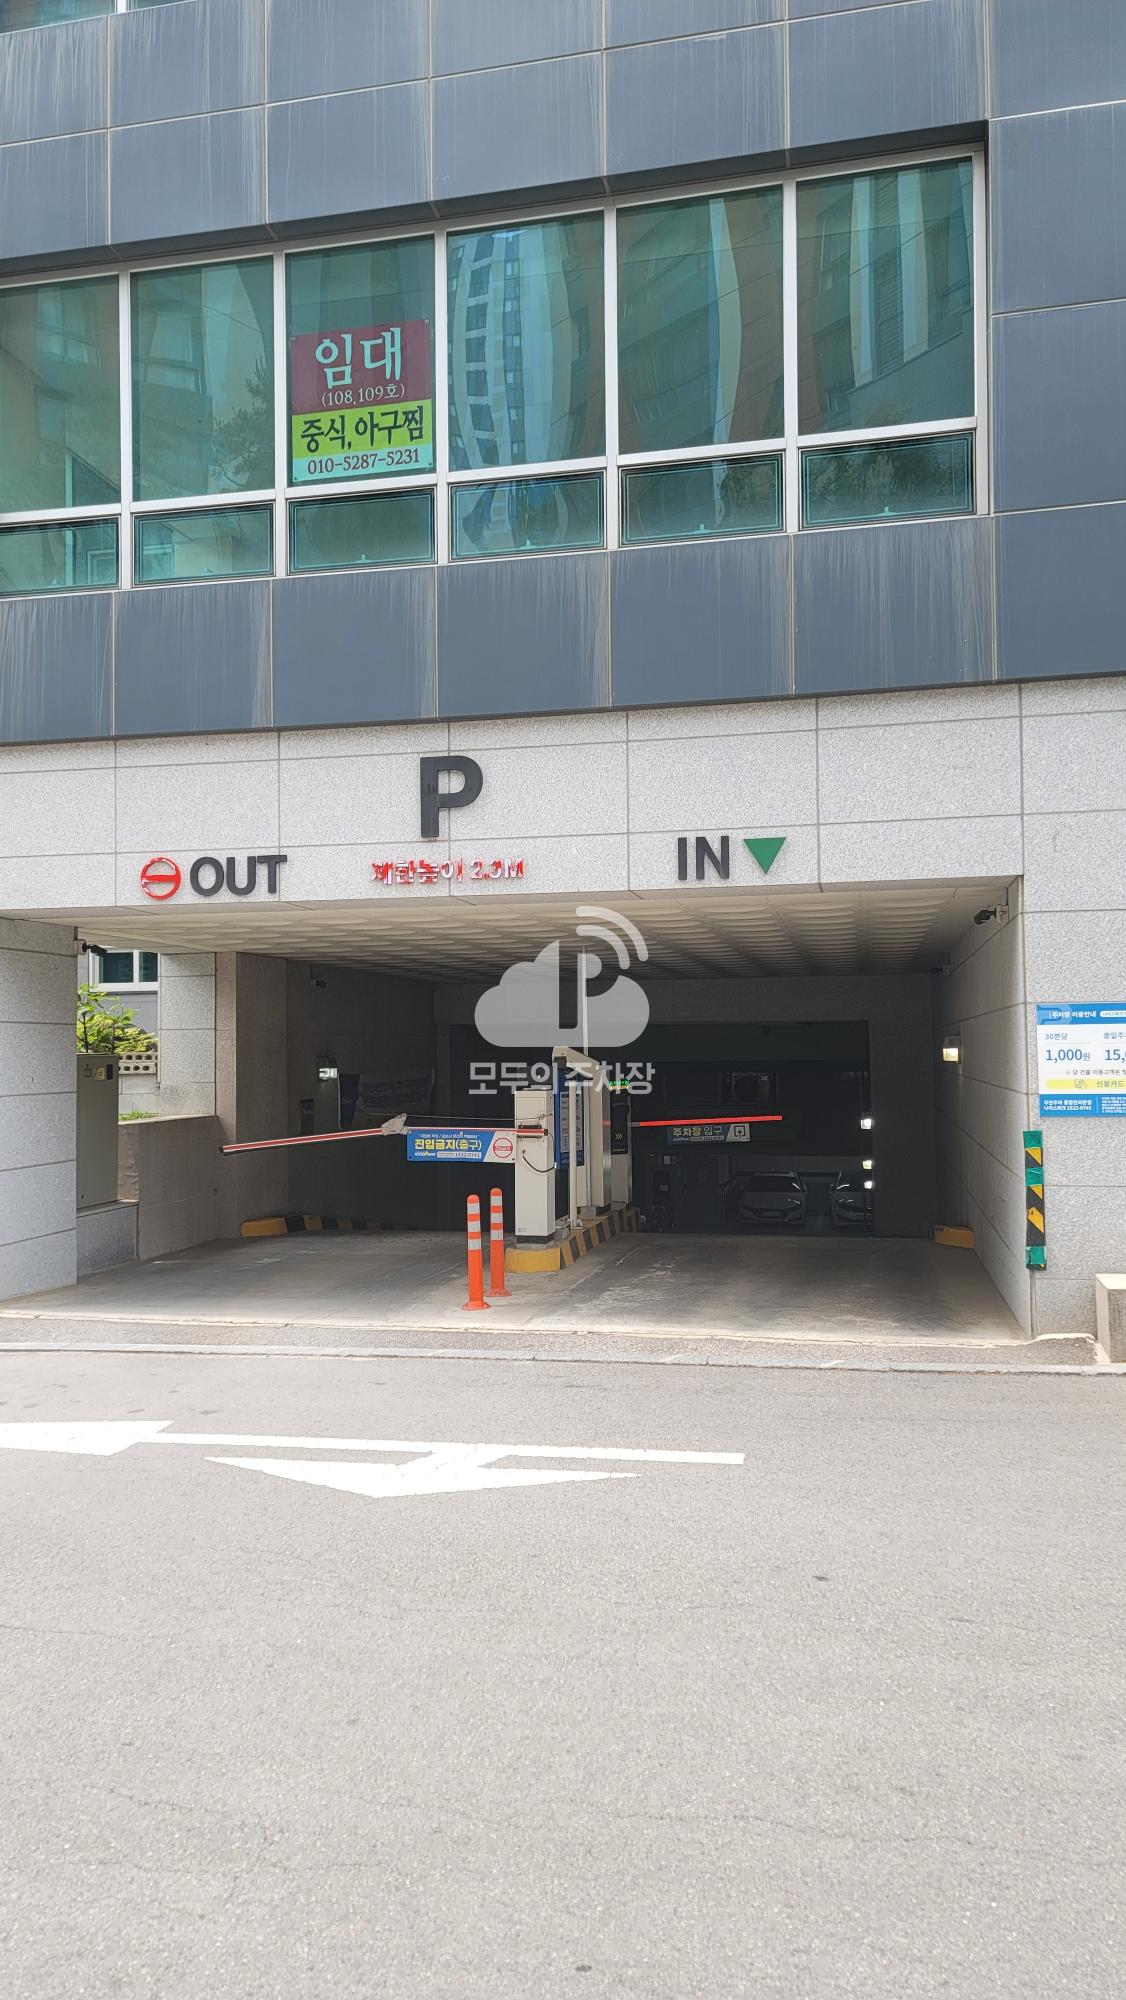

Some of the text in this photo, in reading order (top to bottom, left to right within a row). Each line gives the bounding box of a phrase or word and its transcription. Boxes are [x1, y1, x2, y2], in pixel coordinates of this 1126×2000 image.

[315, 327, 401, 389] 임대
[322, 383, 405, 407] (108,109호)
[307, 447, 420, 475] 010-5287-5231
[420, 755, 483, 838] P
[677, 835, 730, 880] IN
[190, 855, 288, 896] OUT
[370, 857, 525, 885] 제한높이 2.3M
[1045, 1032, 1068, 1040] 30분당
[1045, 1049, 1091, 1063] 1,000원
[1104, 1049, 1126, 1063] 15,
[1096, 1080, 1124, 1088] 신용카드
[672, 1125, 723, 1137] 주차장 입구
[414, 1138, 482, 1150] 진입금지(출구)
